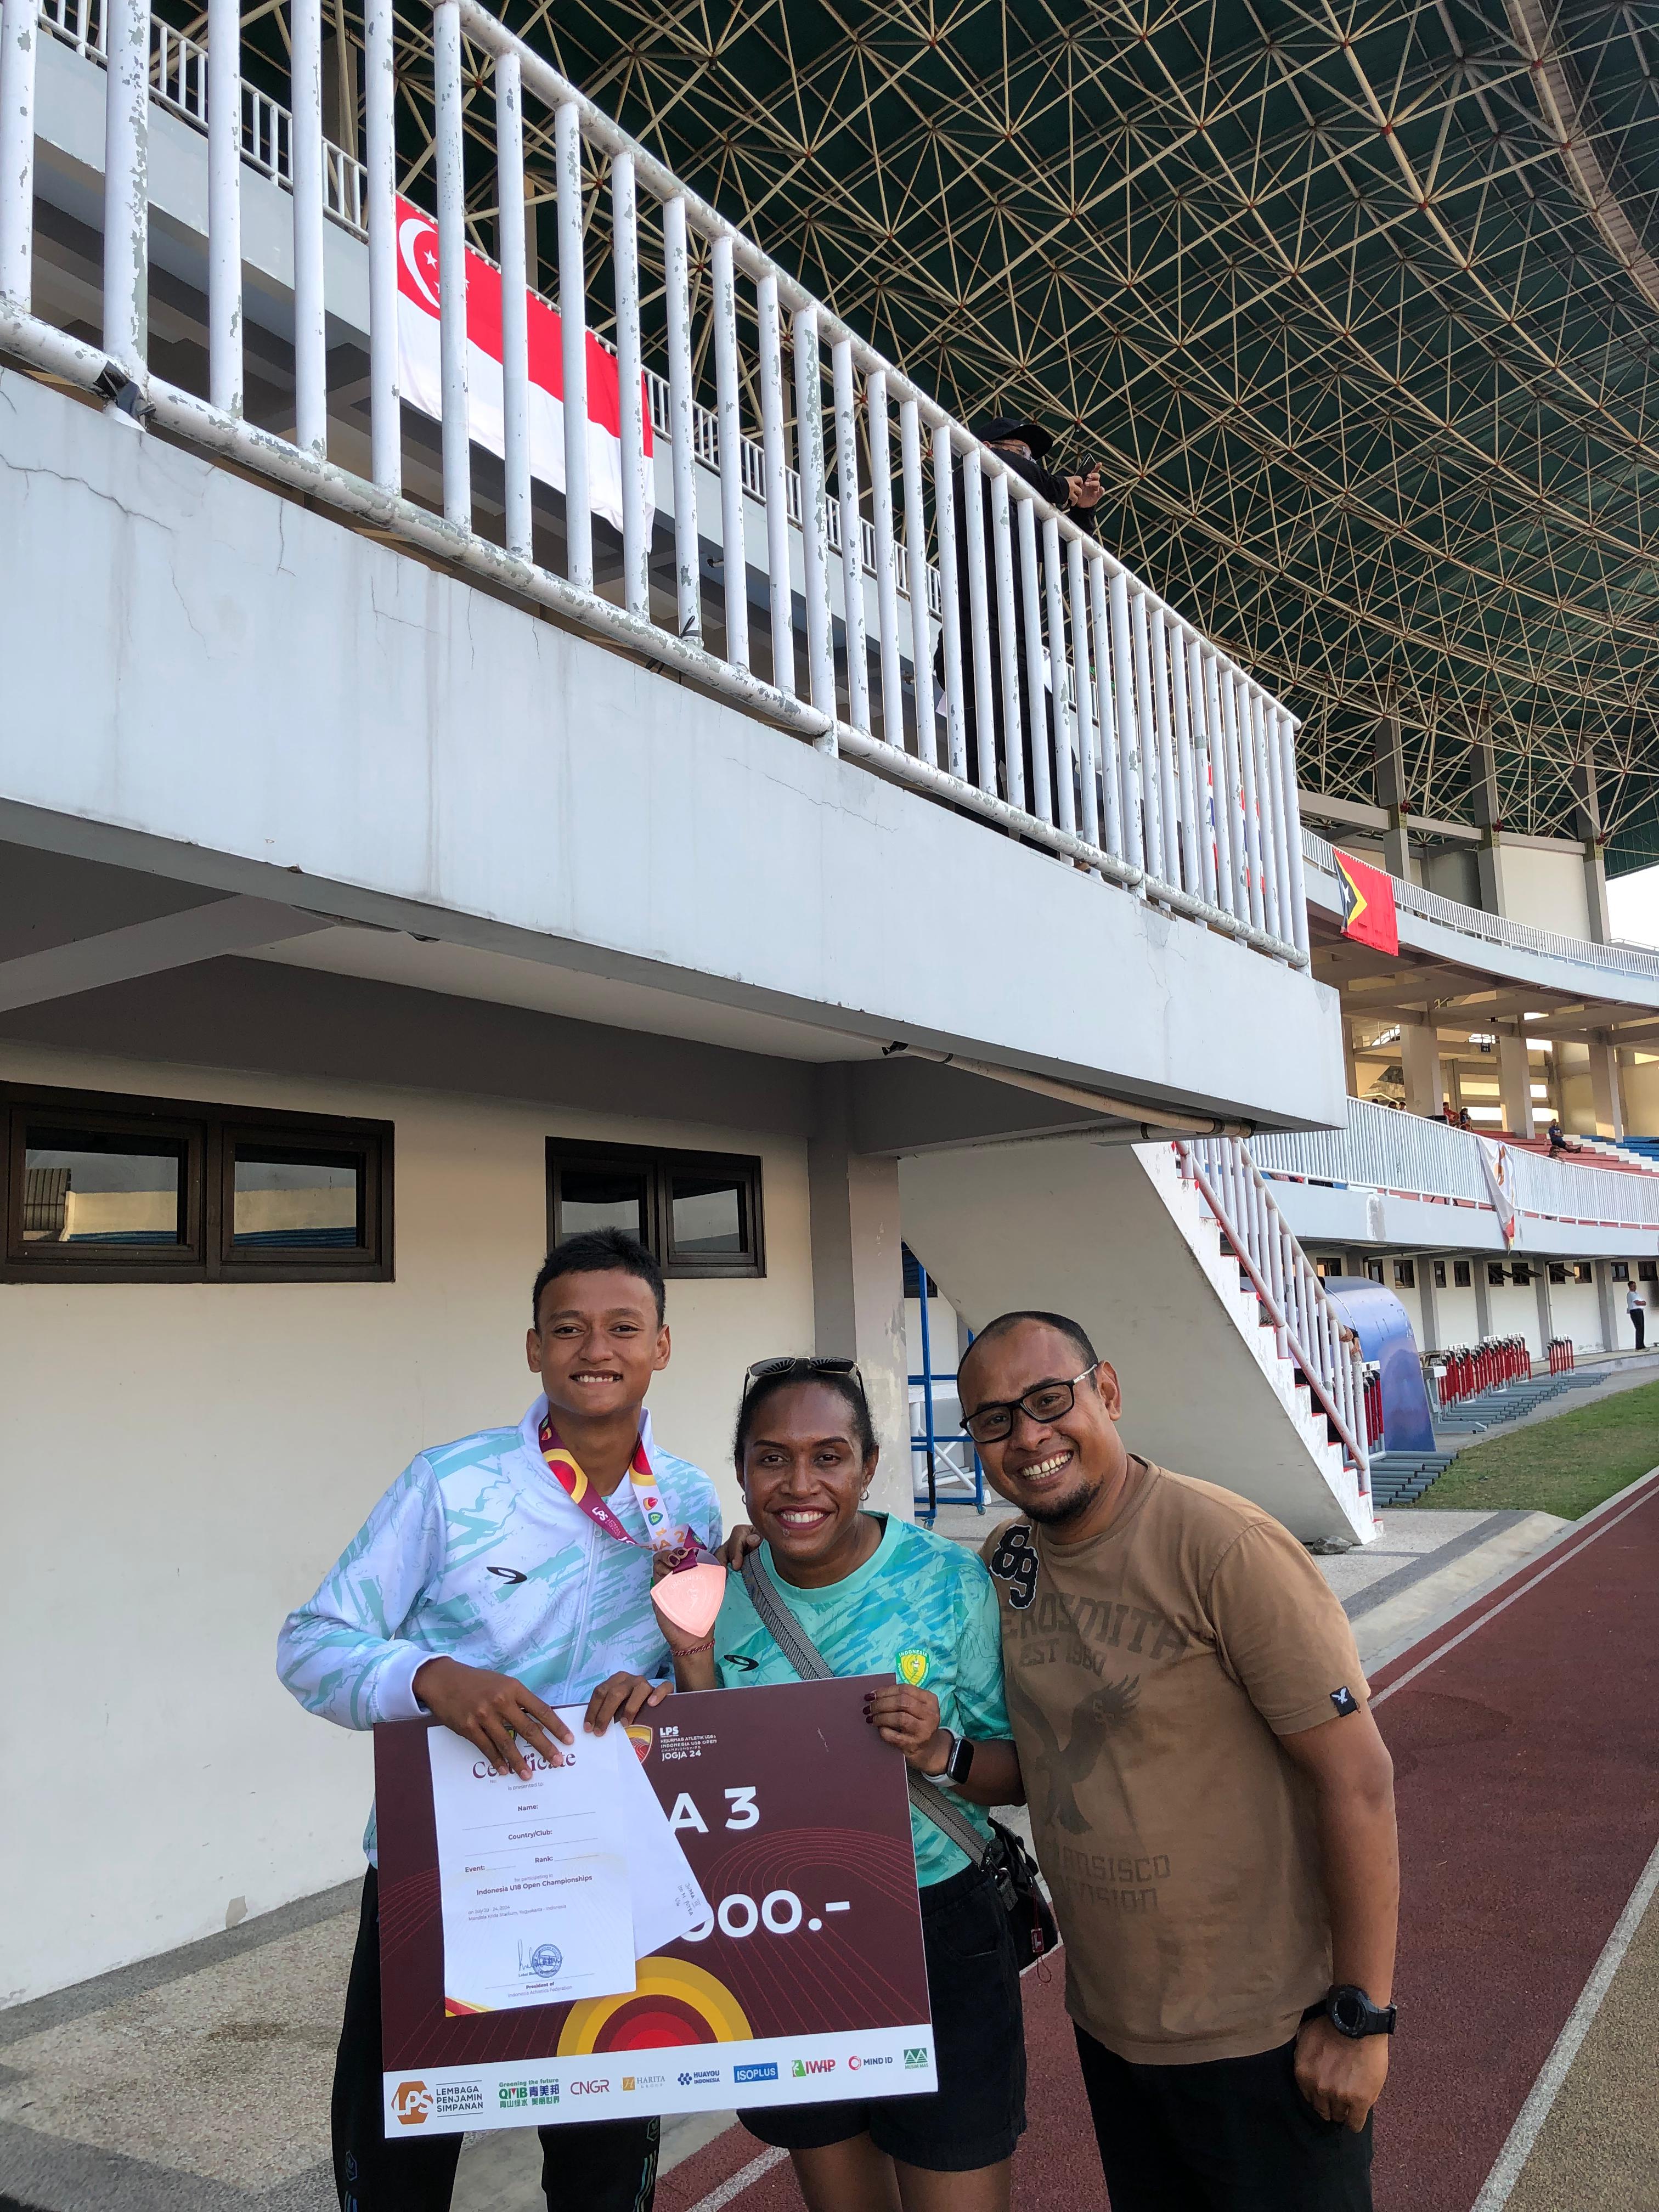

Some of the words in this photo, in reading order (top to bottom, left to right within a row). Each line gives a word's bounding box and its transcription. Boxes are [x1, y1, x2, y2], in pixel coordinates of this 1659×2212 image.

[592, 1506, 608, 1521] LPS
[989, 1523, 1039, 1609] 89
[899, 1649, 927, 1657] INDONESIA
[659, 1726, 679, 1736] LPS
[662, 1751, 687, 1762] JOGJA
[689, 1749, 702, 1758] 24
[513, 1782, 537, 1791] presented
[725, 1786, 760, 1830] 3
[508, 1830, 553, 1840] Country/Club:
[521, 1874, 549, 1882] participating
[477, 1887, 509, 1895] Indonesia
[542, 1875, 592, 1887] Championships
[805, 2059, 836, 2074] IWIP
[863, 2057, 884, 2066] MIND
[637, 2075, 665, 2084] HARITA
[693, 2070, 720, 2078] HUAYOU
[737, 2067, 776, 2081] ISOPLUS
[436, 2085, 479, 2096] LEMBAGA
[570, 2079, 610, 2095] CNGR
[437, 2093, 483, 2104] PENJAMIN
[499, 2087, 528, 2100] QMB
[393, 2089, 434, 2115] LPS
[437, 2101, 483, 2113] SIMPANAN
